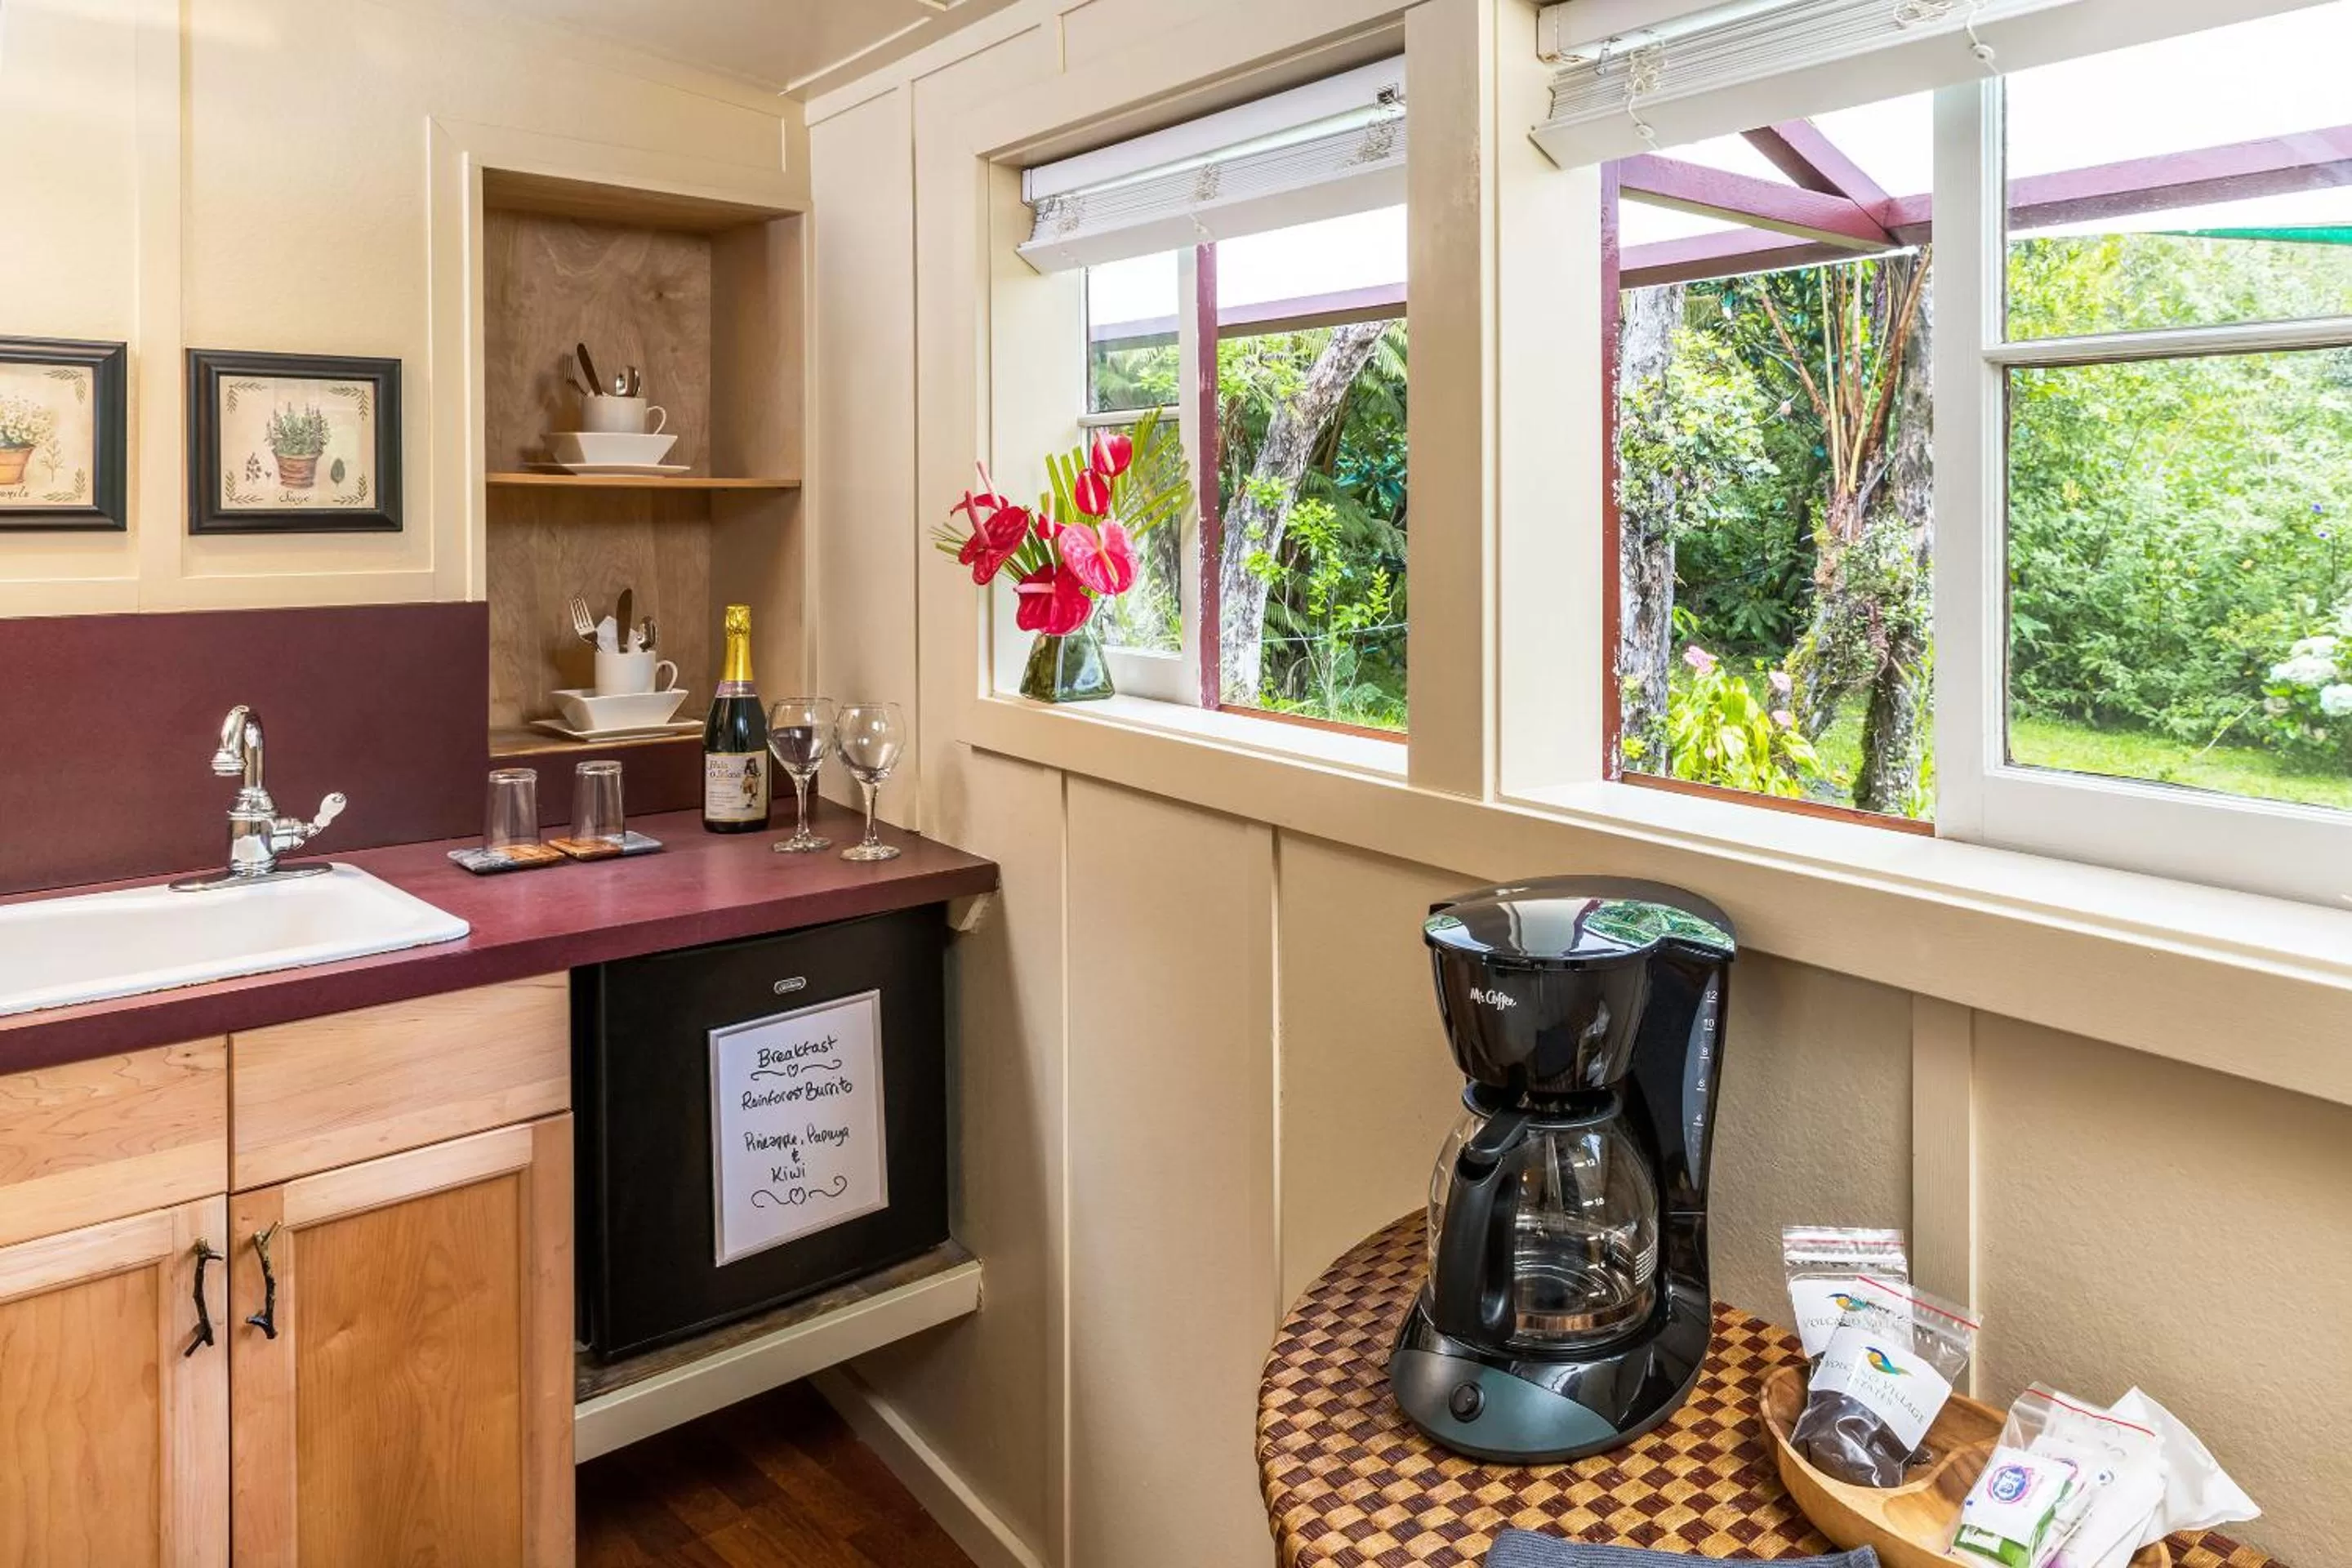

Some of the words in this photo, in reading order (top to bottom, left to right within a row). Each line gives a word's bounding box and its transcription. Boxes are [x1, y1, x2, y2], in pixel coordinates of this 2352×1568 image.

[1486, 989, 1517, 1010] Coffee
[1706, 991, 1717, 1000] 12
[1704, 1018, 1715, 1027] 10
[757, 1034, 838, 1068] Breakfast
[1701, 1047, 1708, 1056] 8
[1698, 1078, 1705, 1088] 6
[805, 1076, 853, 1101] Burrito
[1695, 1113, 1703, 1122] 4
[1586, 1158, 1597, 1168] 12
[771, 1162, 805, 1183] Kiwi
[1594, 1197, 1605, 1206] 10
[1824, 1359, 1879, 1383] VOLCO
[1883, 1379, 1927, 1423] VILLAGE
